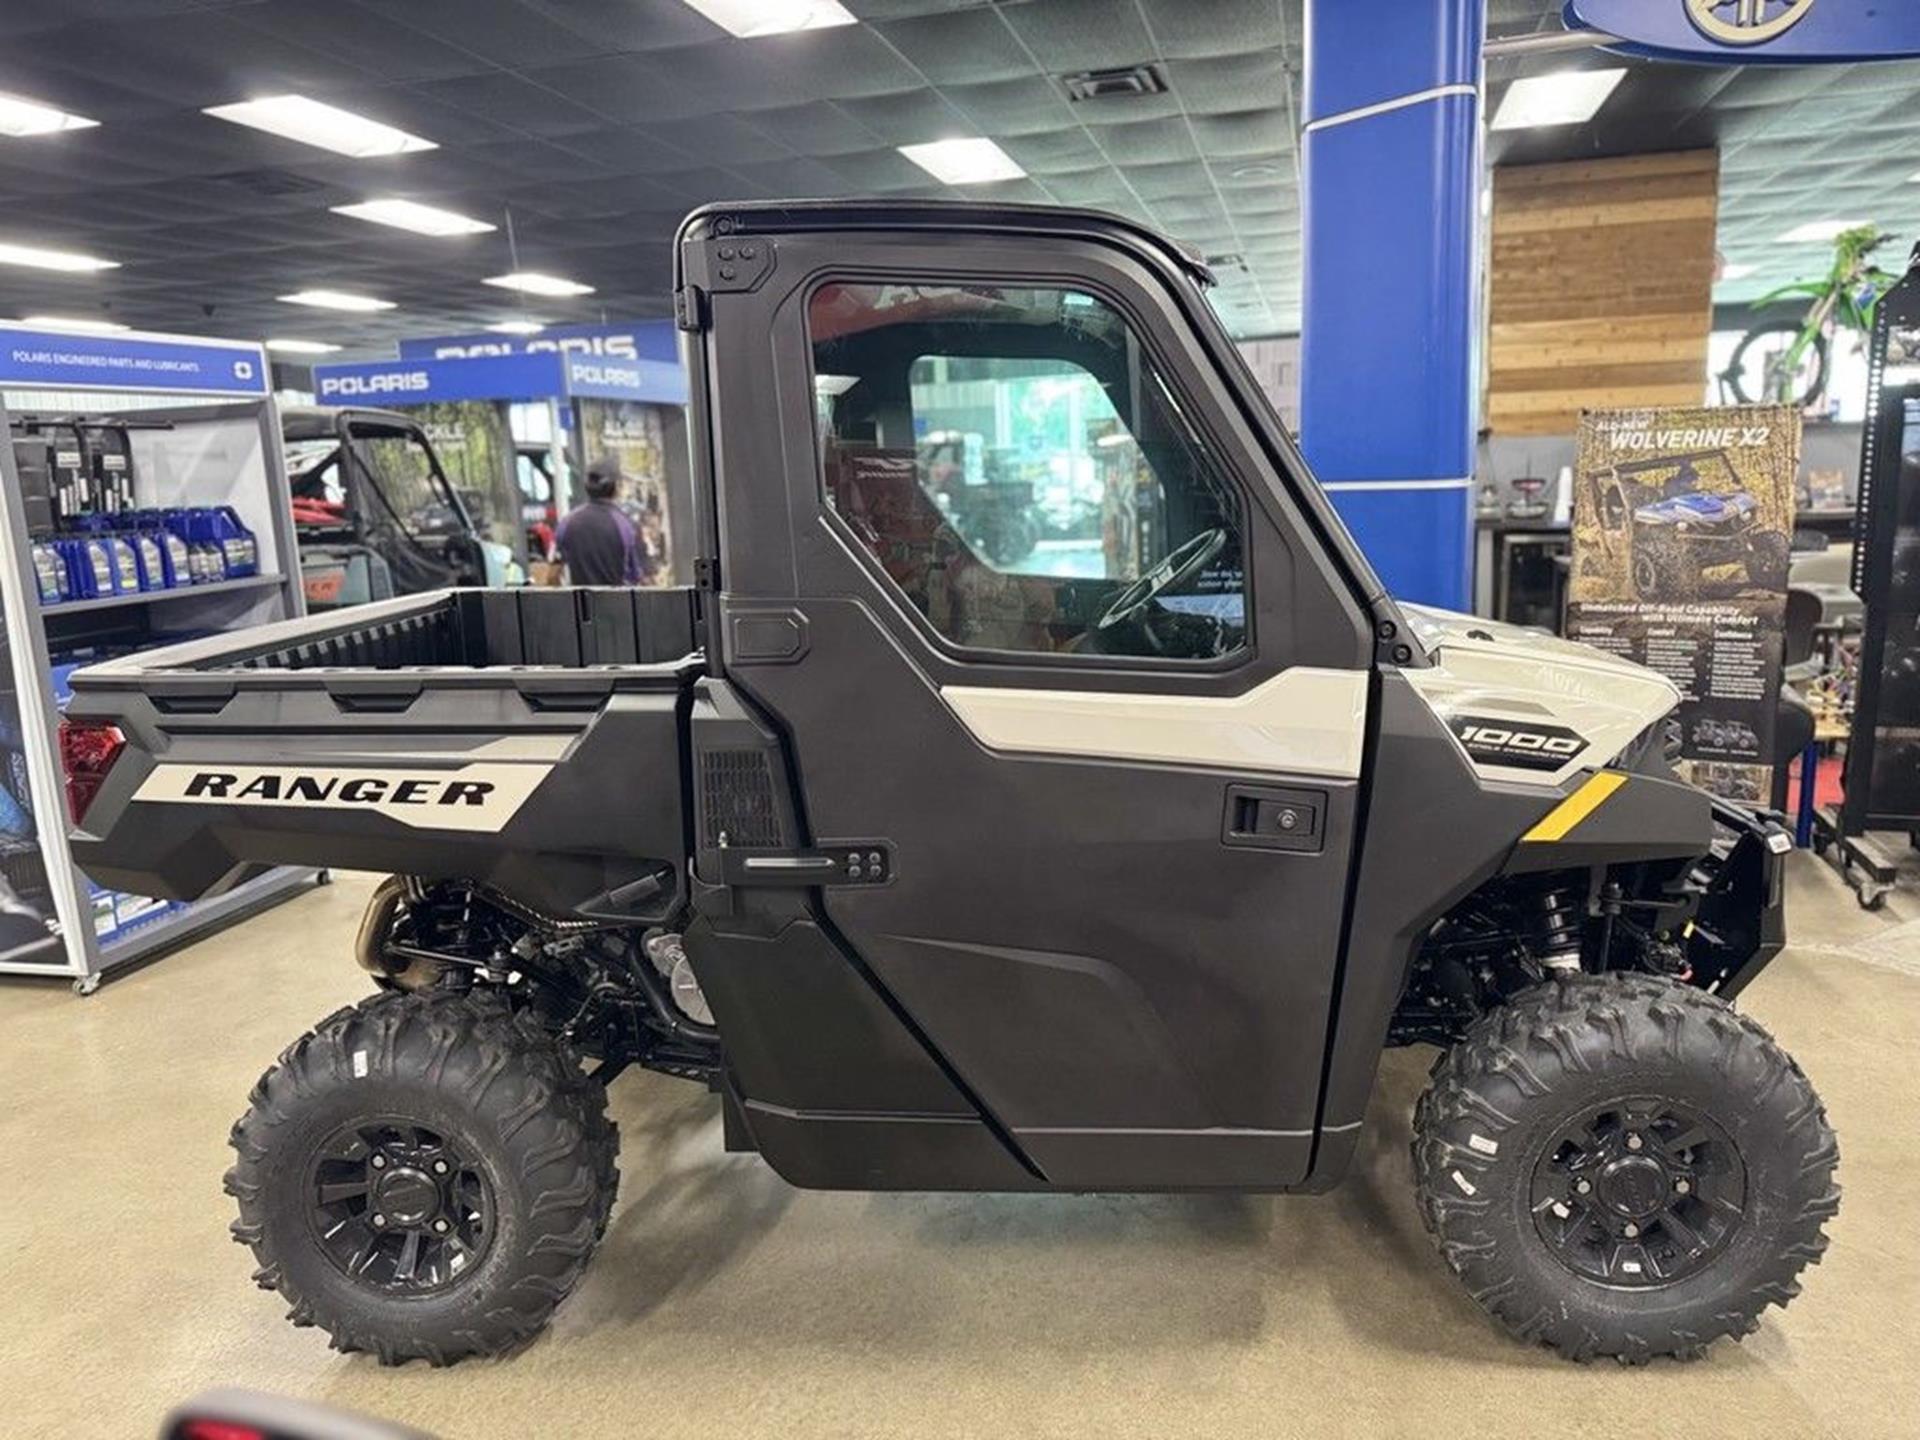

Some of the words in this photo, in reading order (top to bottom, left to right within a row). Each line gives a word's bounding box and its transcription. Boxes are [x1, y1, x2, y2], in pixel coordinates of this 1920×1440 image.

[435, 334, 638, 361] PORIS
[12, 350, 52, 364] POLARIS
[53, 353, 107, 367] ENGINEERED
[108, 357, 134, 368] PARTS
[135, 359, 152, 370] AND
[153, 360, 200, 373] LUBRICANTS
[321, 372, 430, 396] POLARIS
[572, 364, 641, 388] POLARIS
[1610, 427, 1738, 450] WOLVERINE
[1738, 426, 1770, 447] X2
[1580, 603, 1637, 613] Unmatched
[1639, 604, 1690, 614] Off-Road
[1691, 605, 1741, 616] Capability
[1642, 614, 1665, 622] with
[1667, 614, 1712, 624] Ultimate
[1714, 615, 1759, 625] Comfort
[1460, 726, 1581, 753] 1000
[183, 773, 495, 806] RANGER
